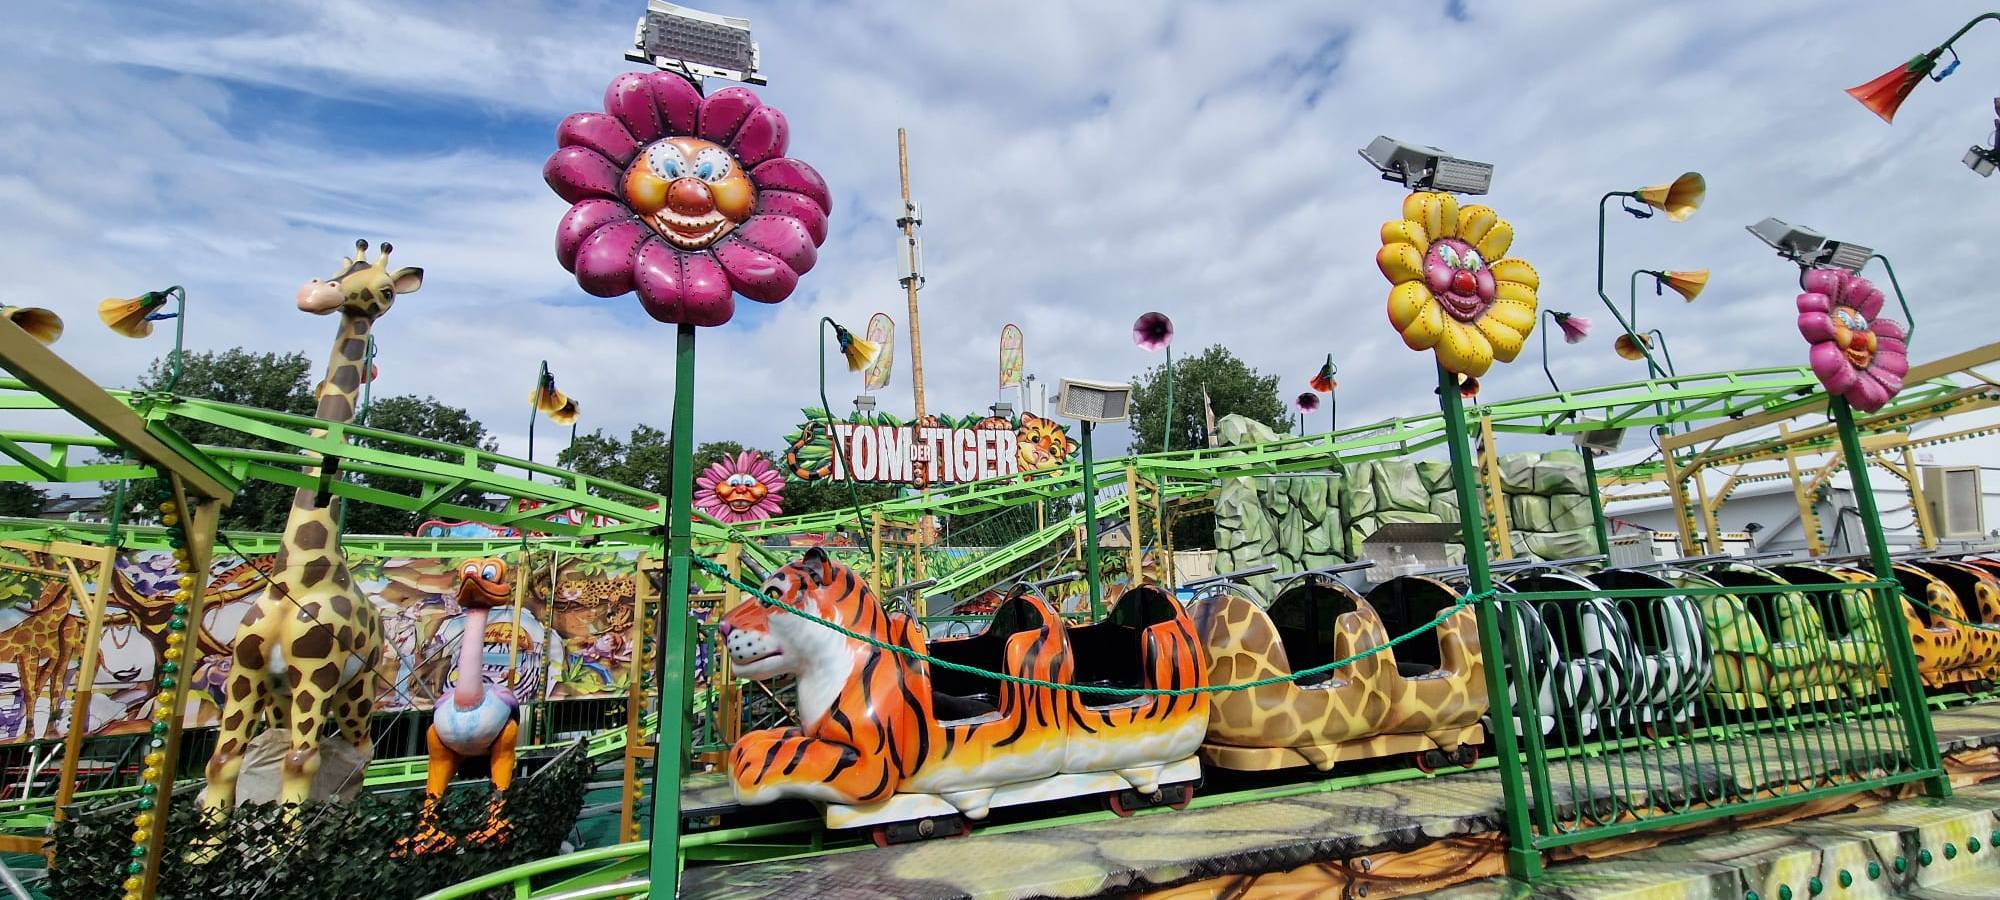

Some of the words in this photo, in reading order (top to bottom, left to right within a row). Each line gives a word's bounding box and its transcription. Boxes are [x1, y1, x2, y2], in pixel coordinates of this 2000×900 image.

[827, 424, 913, 481] TOM
[910, 444, 931, 461] DER
[920, 427, 1019, 482] TIGER
